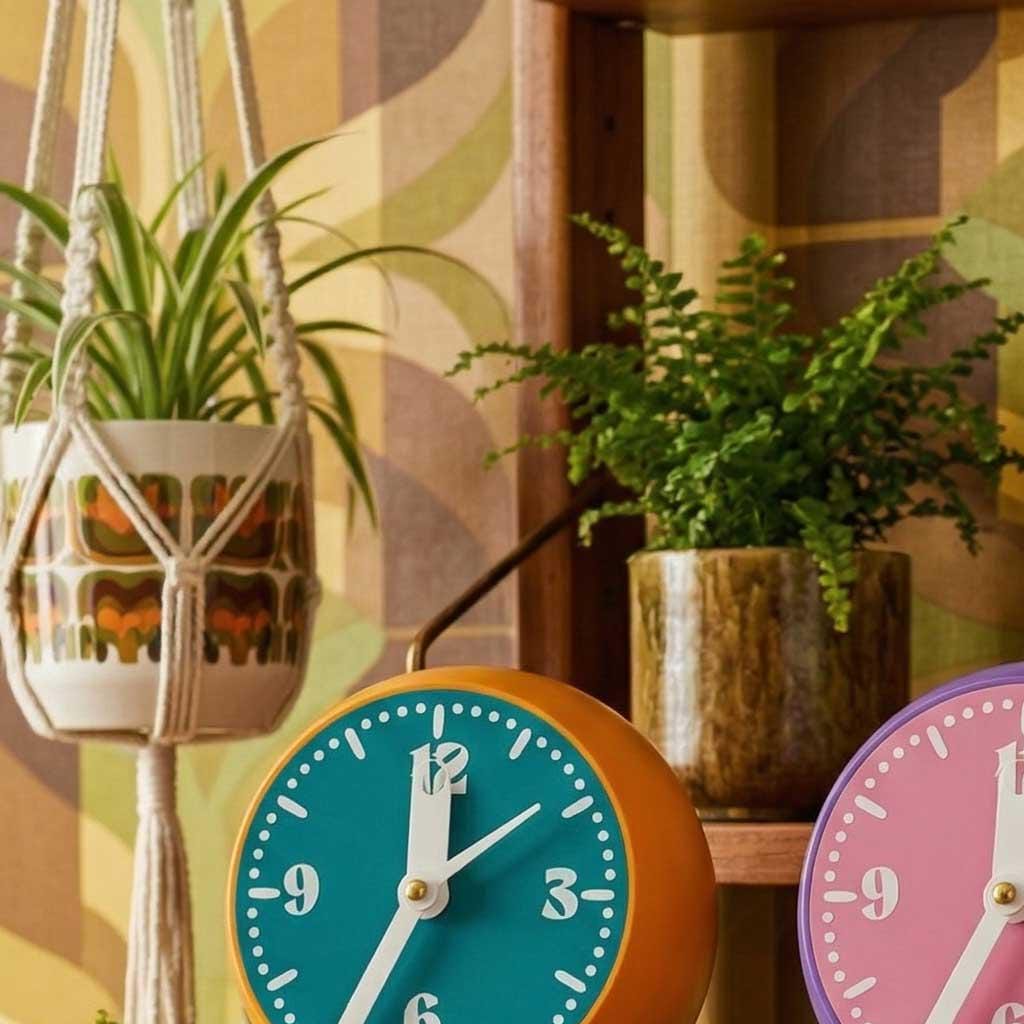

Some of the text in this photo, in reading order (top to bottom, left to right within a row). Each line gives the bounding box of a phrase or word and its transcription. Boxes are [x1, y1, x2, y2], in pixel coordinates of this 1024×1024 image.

[409, 741, 469, 795] 12
[283, 863, 320, 917] 9
[541, 867, 579, 921] 3
[861, 866, 900, 921] 9
